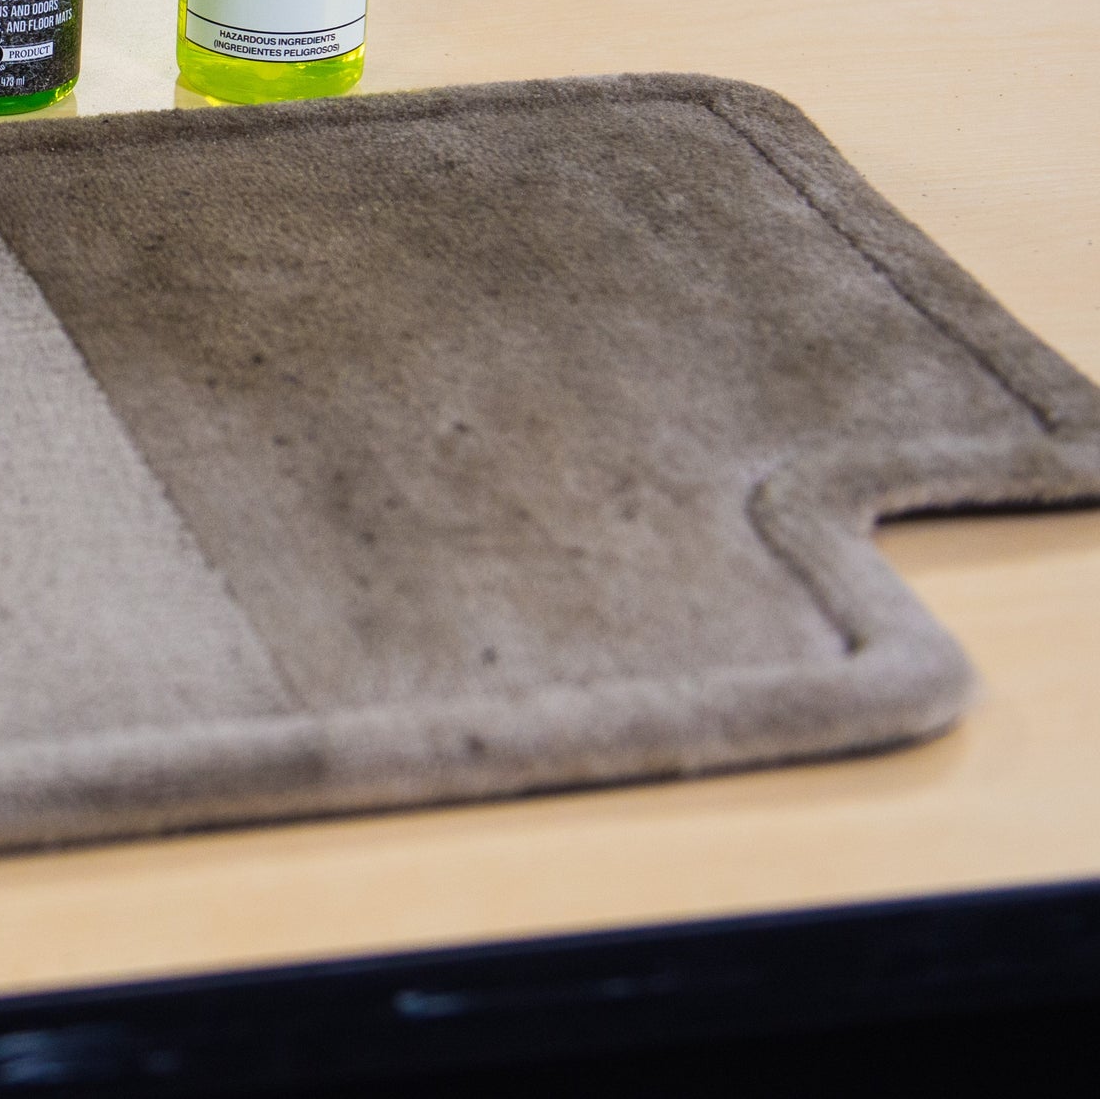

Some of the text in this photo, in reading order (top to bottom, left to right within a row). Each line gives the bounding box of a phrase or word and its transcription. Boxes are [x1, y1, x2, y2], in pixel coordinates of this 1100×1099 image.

[11, 4, 30, 17] AND
[6, 21, 27, 33] AND
[28, 16, 54, 32] FLOOR
[55, 8, 73, 25] MATS
[219, 29, 336, 46] HAZARDOUS INGREDIENTS
[9, 45, 51, 59] PRODUCT
[214, 39, 340, 57] (INGREDIENTES PELIGROSOS)
[1, 75, 15, 86] 473
[16, 75, 25, 86] ml
